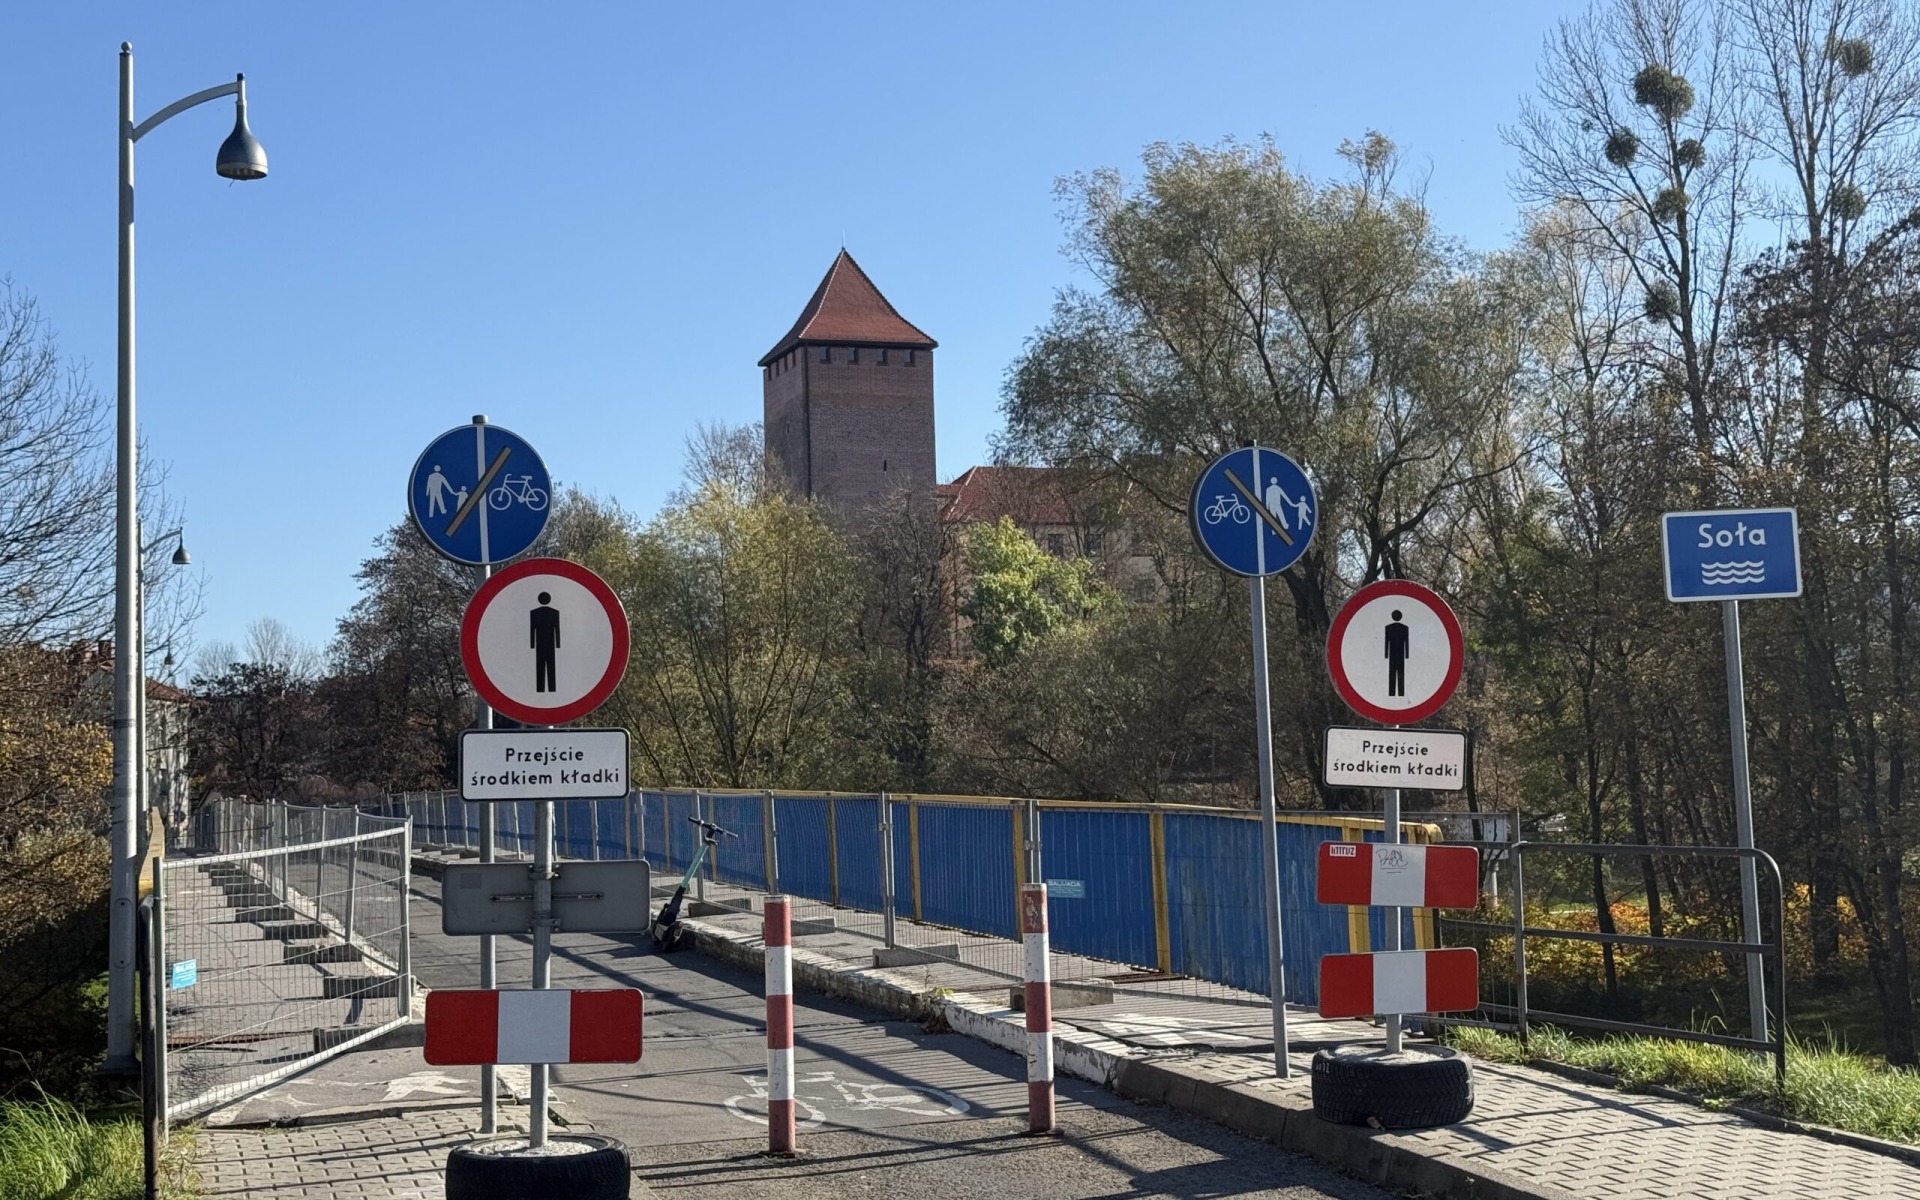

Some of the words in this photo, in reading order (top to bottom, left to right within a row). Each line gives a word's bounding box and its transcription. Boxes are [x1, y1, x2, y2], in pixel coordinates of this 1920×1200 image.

[1698, 522, 1767, 548] Soła
[505, 746, 584, 766] Przejście
[1362, 740, 1429, 758] Przejście
[471, 770, 553, 786] środkiem
[560, 768, 620, 784] kładki
[1333, 759, 1401, 774] środkiem
[1407, 762, 1458, 777] kładki
